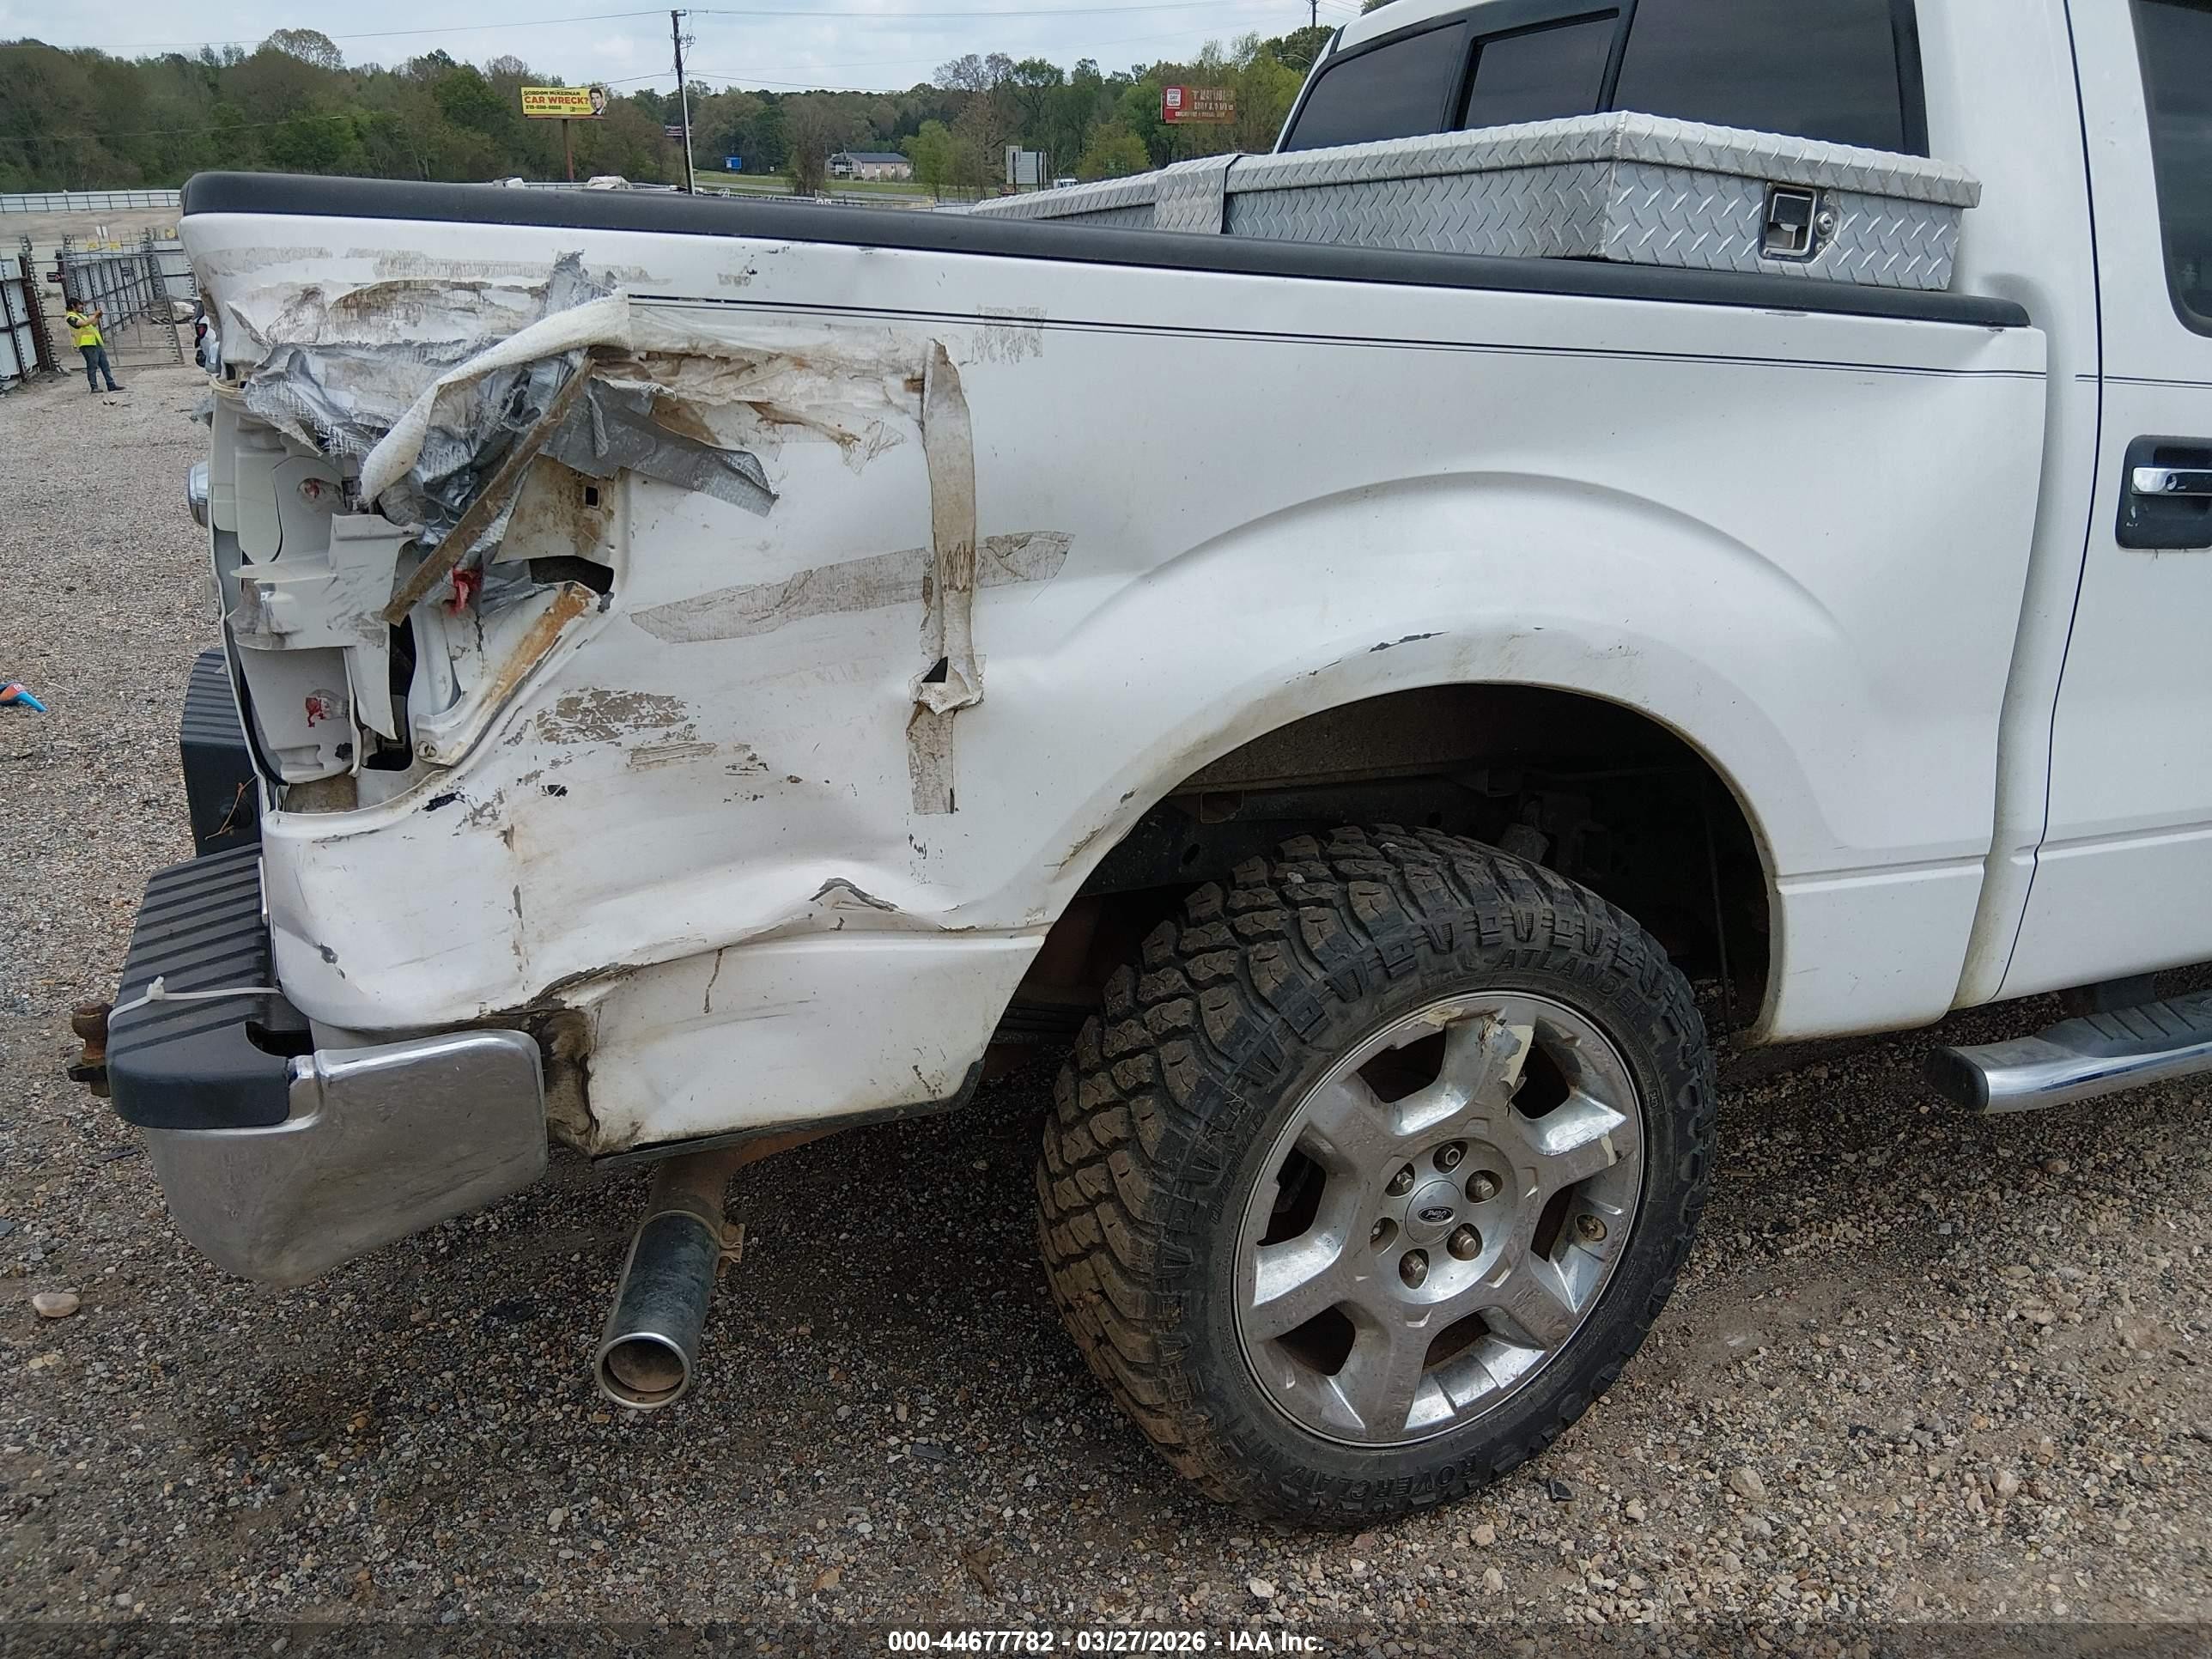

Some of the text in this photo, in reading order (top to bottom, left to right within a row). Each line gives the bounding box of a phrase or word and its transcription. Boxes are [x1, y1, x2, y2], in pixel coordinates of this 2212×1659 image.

[548, 96, 589, 105] WRECK?
[1494, 945, 1651, 1032] ATLANDER
[1425, 1209, 1448, 1219] Ford
